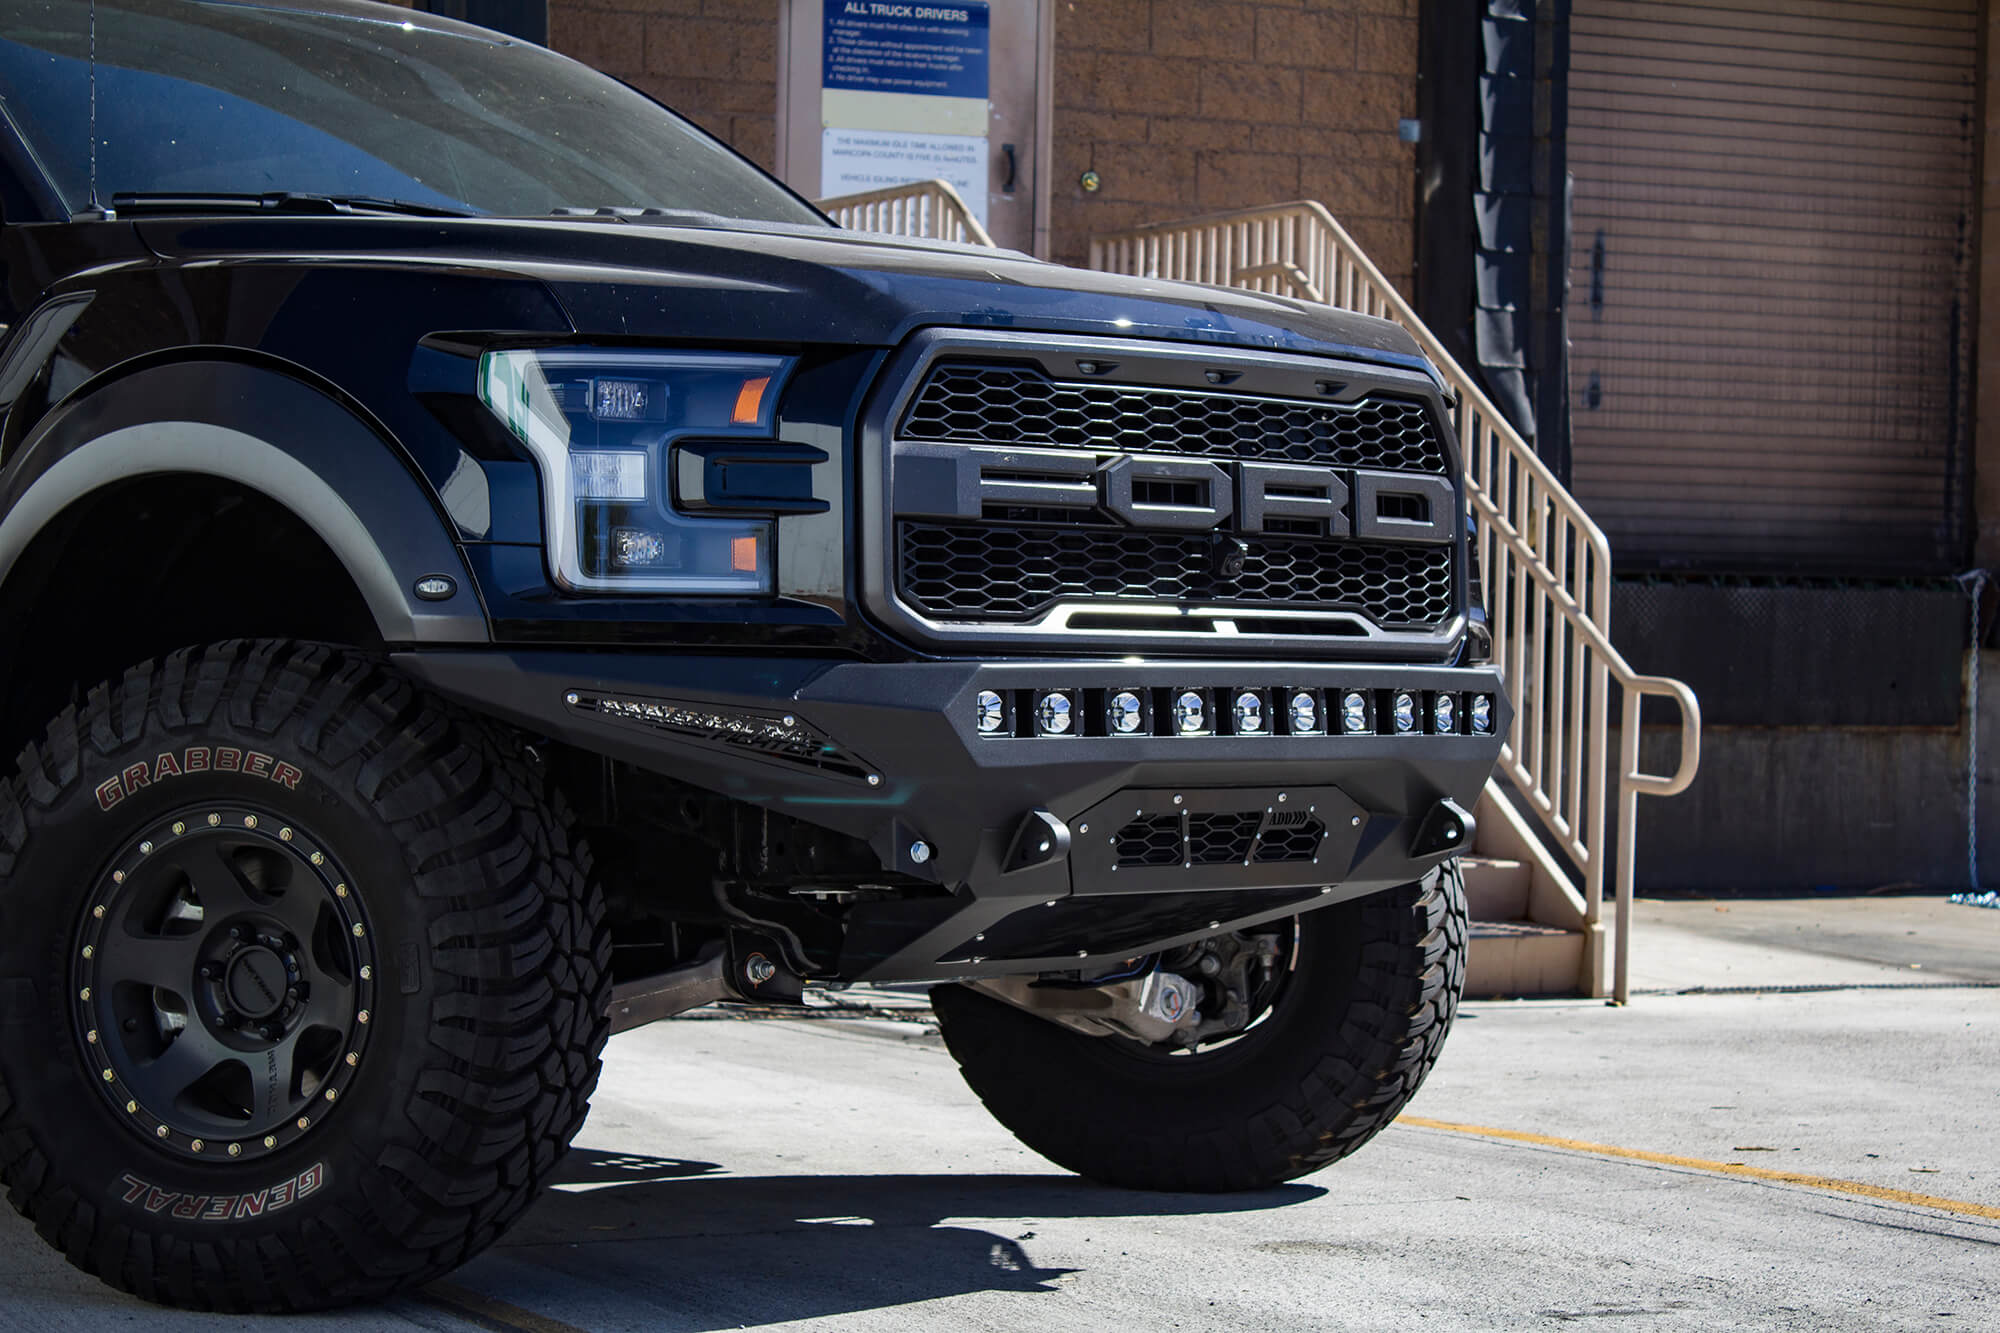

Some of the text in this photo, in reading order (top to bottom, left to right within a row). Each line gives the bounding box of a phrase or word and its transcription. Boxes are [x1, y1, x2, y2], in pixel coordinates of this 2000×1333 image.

[844, 2, 969, 21] ALL TRUCK DRIVERS
[837, 137, 851, 145] THE
[853, 138, 890, 147] MAXIMUM
[892, 140, 908, 148] IDLE
[910, 141, 927, 149] TIME
[929, 143, 964, 152] ALLOWED
[832, 148, 872, 157] MARICOPA
[873, 151, 904, 160] COUNTY
[915, 153, 930, 161] FIVE
[840, 173, 871, 182] VEHICLE
[873, 175, 898, 184] IDLING
[957, 446, 1456, 544] FORD
[96, 747, 303, 811] GRABBER
[122, 1163, 323, 1220] GENERAL
